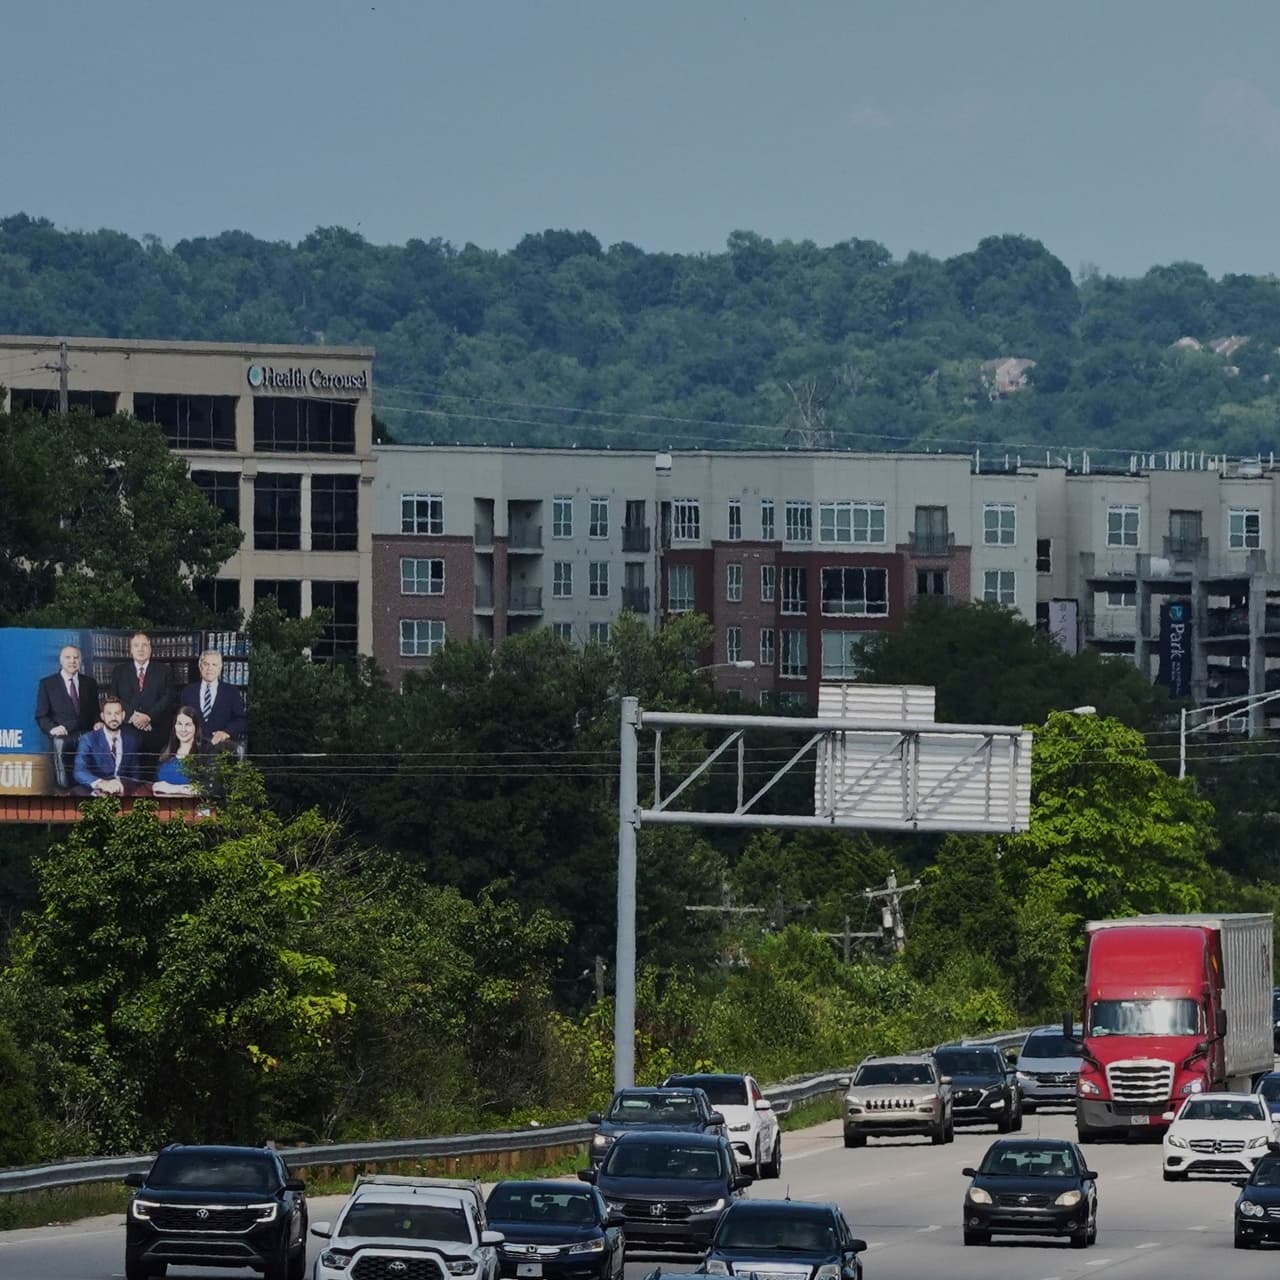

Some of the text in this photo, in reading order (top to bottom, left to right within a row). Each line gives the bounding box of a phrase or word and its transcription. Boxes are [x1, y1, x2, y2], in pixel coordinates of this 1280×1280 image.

[262, 367, 369, 389] Health Carousel
[1170, 623, 1185, 660] Park
